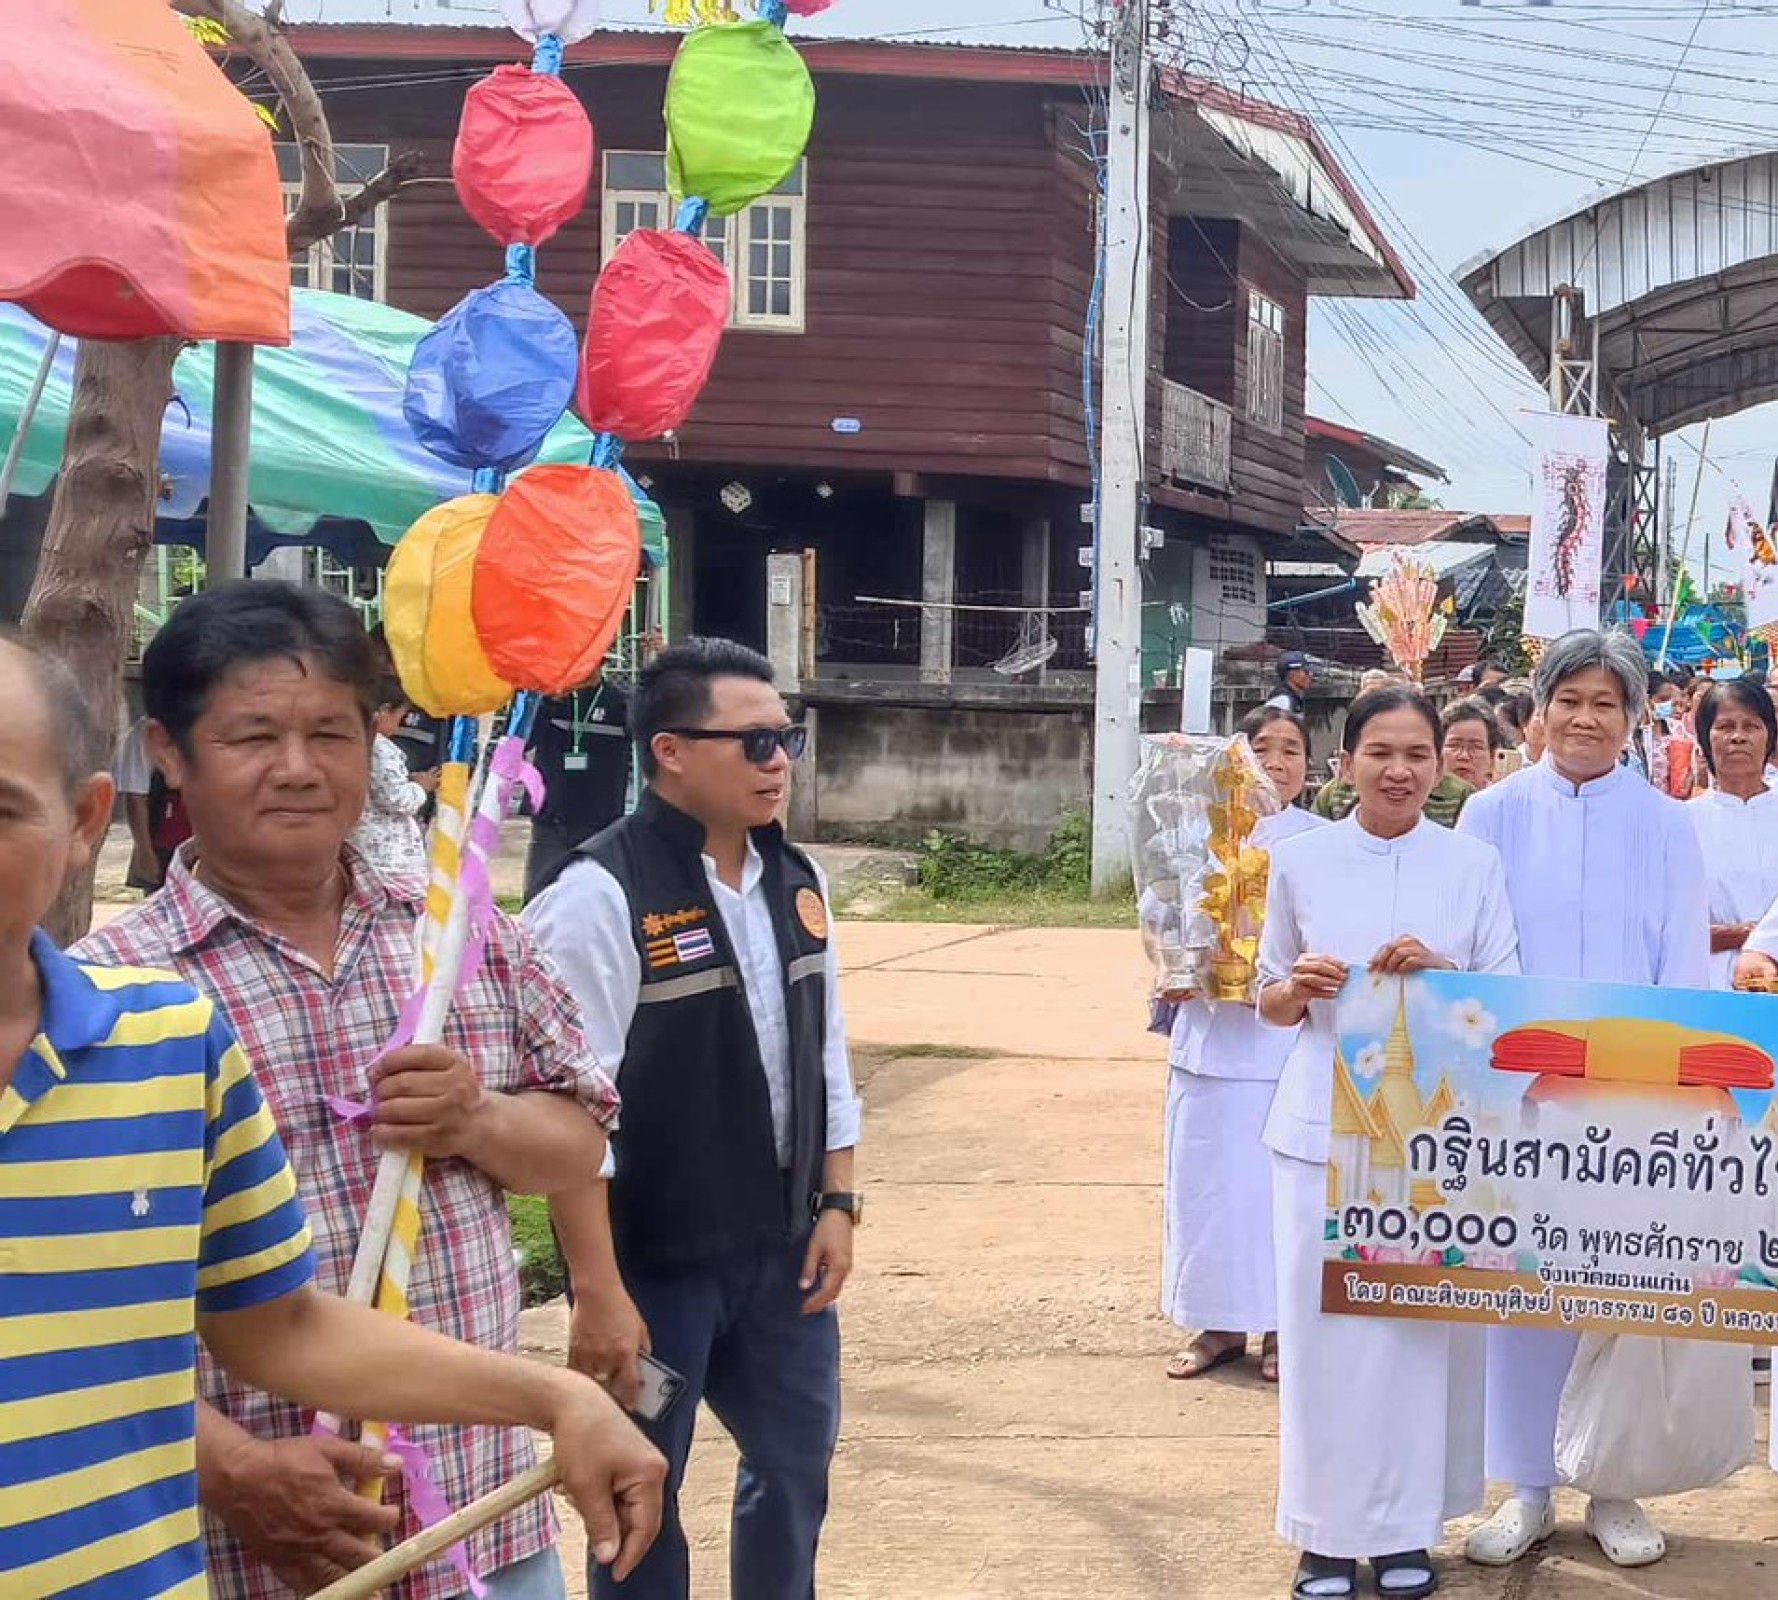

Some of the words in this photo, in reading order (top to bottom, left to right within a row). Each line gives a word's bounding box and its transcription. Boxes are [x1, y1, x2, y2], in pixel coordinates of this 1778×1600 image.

[1343, 1204, 1518, 1250] ๓๐,๐๐๐
[1531, 1212, 1569, 1251] วัด
[1579, 1221, 1744, 1266] พุทธศักราช
[1345, 1273, 1384, 1302] โดย
[1392, 1282, 1552, 1320] คณะศิษยานุศิษย์
[1559, 1297, 1656, 1322] บูชาธรรม
[1662, 1305, 1692, 1325] ๘๑
[1700, 1300, 1716, 1326] ปี
[1538, 1261, 1692, 1292] จังหวัดขอนแก่น
